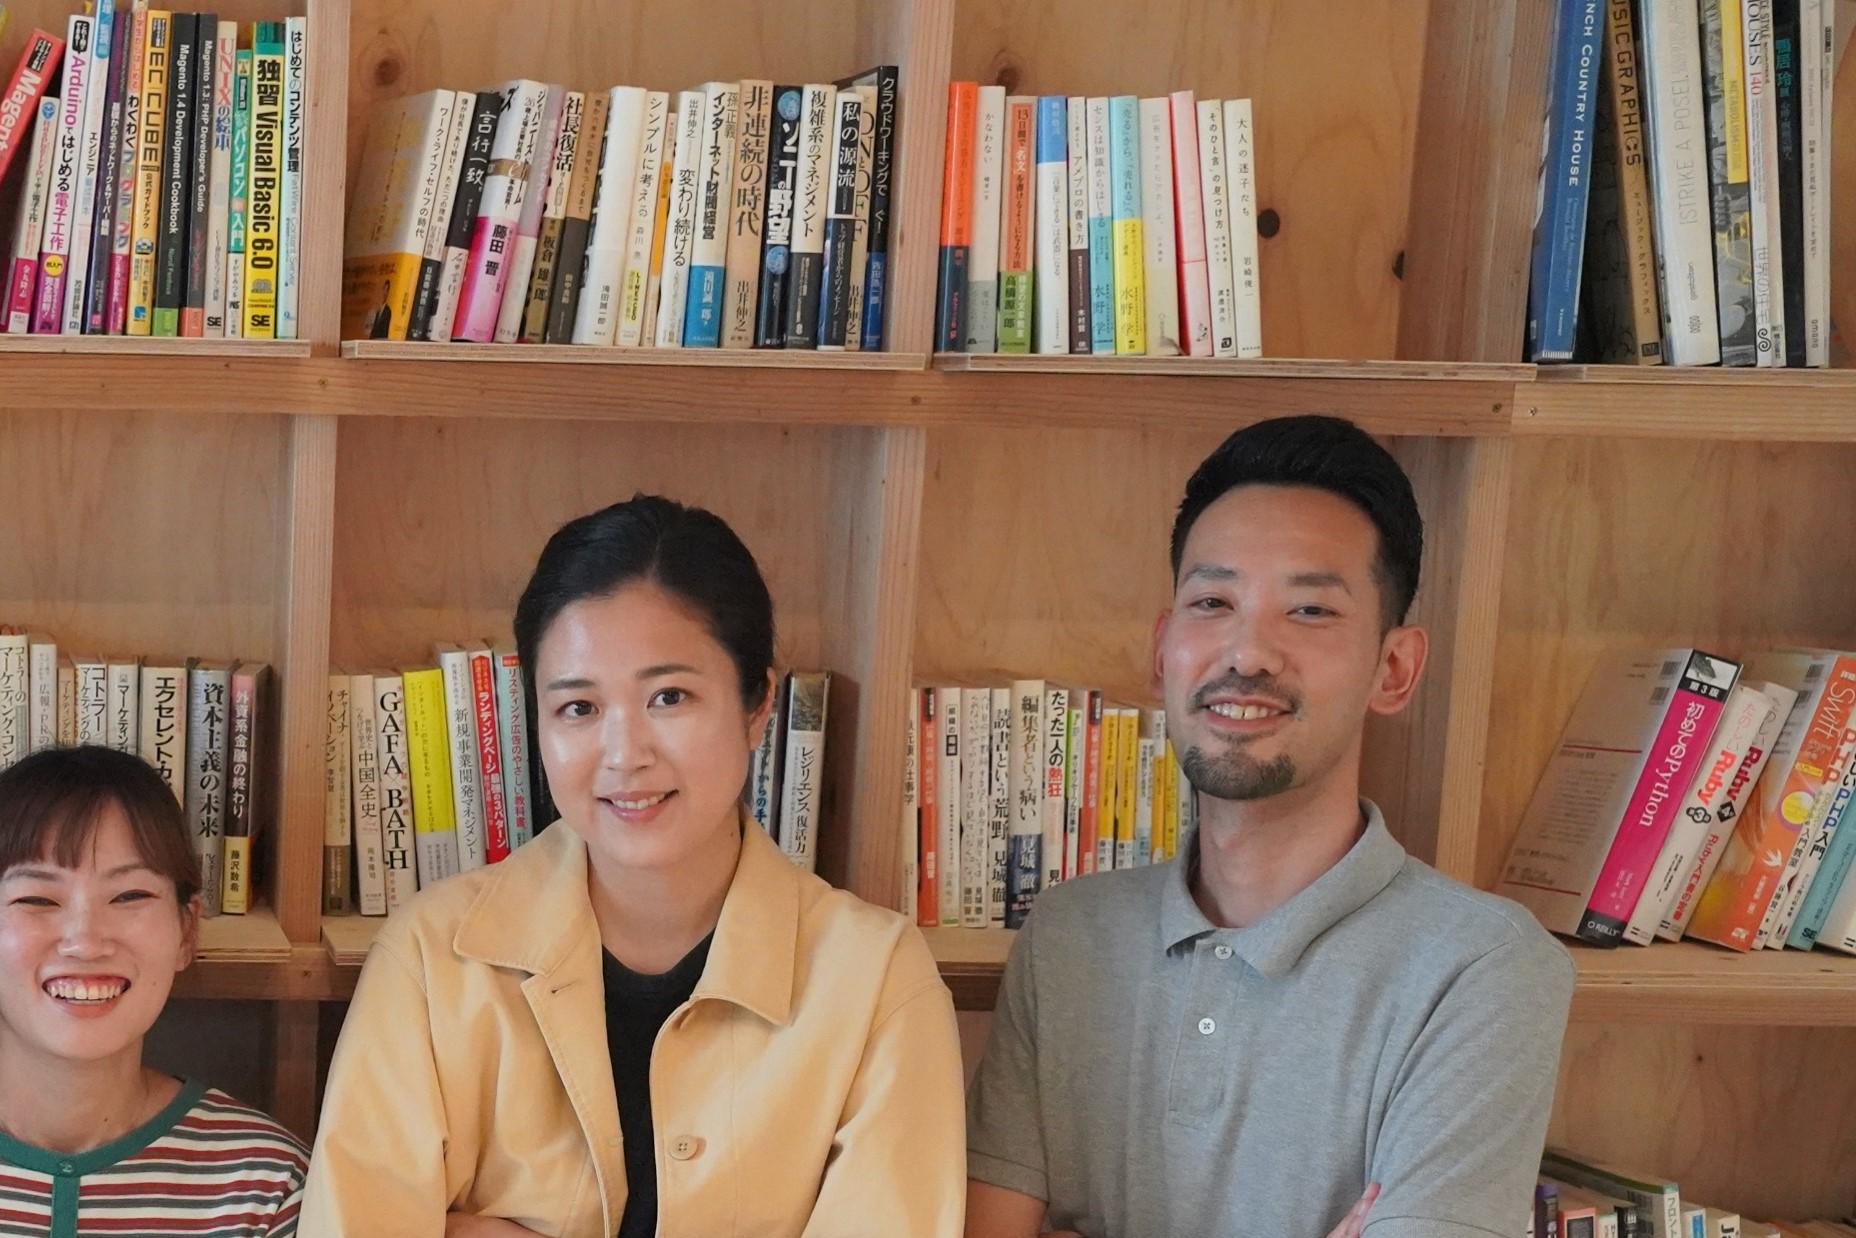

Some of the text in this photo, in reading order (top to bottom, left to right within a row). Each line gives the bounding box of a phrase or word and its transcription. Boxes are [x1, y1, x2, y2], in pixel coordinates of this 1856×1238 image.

[203, 40, 213, 82] Magento
[1575, 44, 1594, 123] COUNTRY
[1748, 0, 1763, 67] OUSES
[169, 44, 190, 234] Magento 1.4 Development Cookbook
[214, 38, 236, 151] UNIXの絵本
[287, 31, 304, 172] はじめてのコンテンツ管理
[556, 98, 583, 172] 社長復活
[837, 102, 861, 188] 私の源流
[1617, 57, 1642, 166] GRAPHICS
[49, 55, 86, 250] Arduinoではじめる電子工作
[251, 60, 280, 270] 独習 Visual Basic 6.0
[415, 107, 448, 239] ワーク・ライフ・セルフの時代
[735, 85, 769, 237] 非連続の時代
[802, 90, 829, 238] 複雑系のマネジメント
[1072, 155, 1087, 245] アメブロの書き方
[1237, 117, 1251, 218] 大人の迷子たち
[1569, 130, 1585, 187] HOUSE
[485, 224, 508, 277] 藤田 晋
[673, 169, 696, 268] 変わり続ける
[251, 315, 271, 327] SE
[1092, 285, 1106, 337] 水野学
[1120, 288, 1134, 337] 水野学
[14, 646, 26, 703] コトラーの
[199, 683, 225, 839] 資本主義の未来
[232, 690, 250, 819] 外資系金融の終わり
[358, 750, 378, 819] 中国全史
[455, 708, 478, 859] 新規事業開発マネジメント
[478, 691, 497, 774] ランディングページ
[508, 669, 527, 829] リスティング広告のやさしい教科書
[991, 709, 1011, 840] 読書という荒野
[1019, 695, 1040, 821] 編集者という病い
[1047, 691, 1066, 798] たった一人の熱狂
[794, 746, 816, 855] レジリエンス 復活力
[230, 849, 241, 893] 藤沢数希
